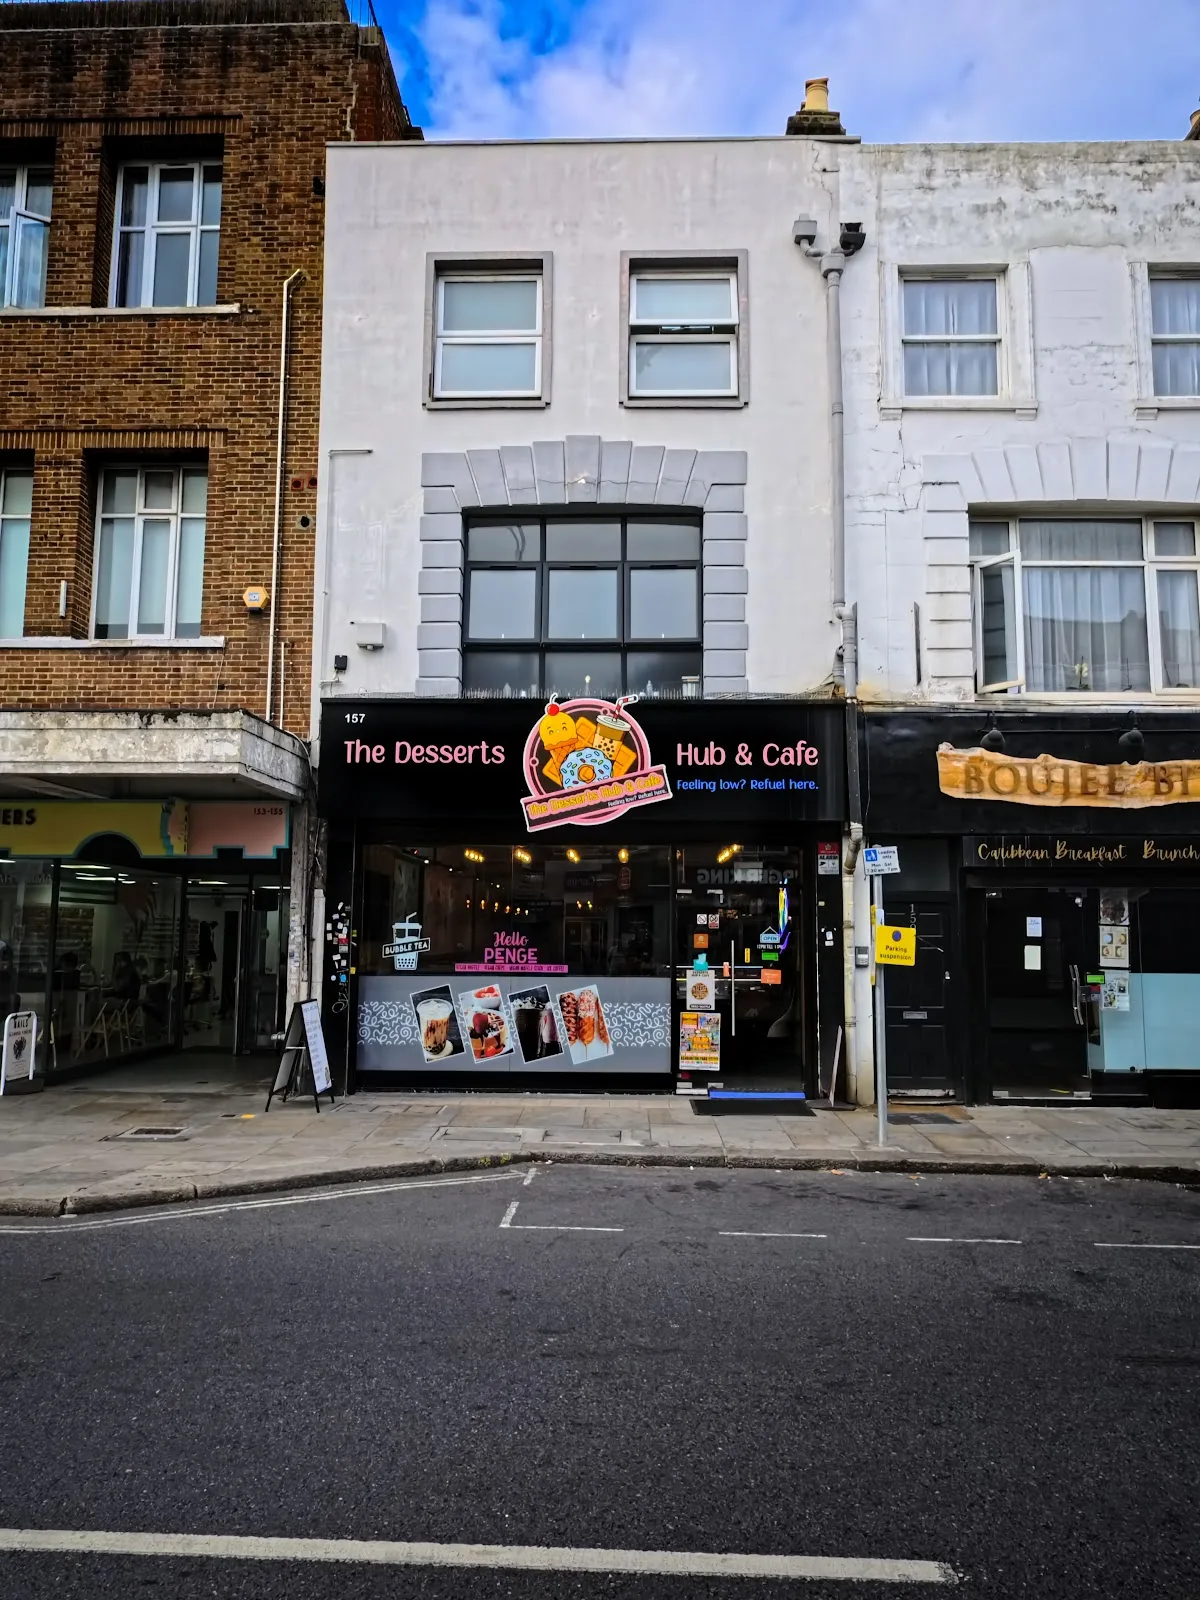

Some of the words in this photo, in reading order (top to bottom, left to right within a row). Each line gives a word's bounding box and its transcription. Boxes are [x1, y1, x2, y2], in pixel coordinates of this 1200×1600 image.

[344, 713, 366, 723] 157
[344, 739, 386, 764] The
[394, 740, 506, 765] Desserts
[676, 741, 726, 766] Hub
[735, 743, 753, 766] &
[762, 739, 819, 767] Cafe
[676, 779, 716, 793] Feeling
[720, 779, 747, 790] low?
[750, 779, 785, 790] Refuel
[789, 779, 819, 790] here.
[528, 802, 548, 816] The
[550, 790, 598, 811] Desserts
[600, 784, 623, 799] Hub
[625, 781, 634, 792] &
[636, 774, 662, 789] Cafe
[0, 808, 37, 825] ERS
[253, 807, 284, 815] 153-155
[977, 843, 1049, 861] Caribbean
[1055, 840, 1128, 862] Breakfast
[1142, 840, 1200, 861] Brunch
[493, 930, 529, 947] Hello
[384, 943, 413, 955] BUBBLE
[413, 940, 428, 951] TEA
[484, 947, 538, 963] PENGE
[885, 945, 908, 953] Parking
[879, 953, 912, 961] suspension
